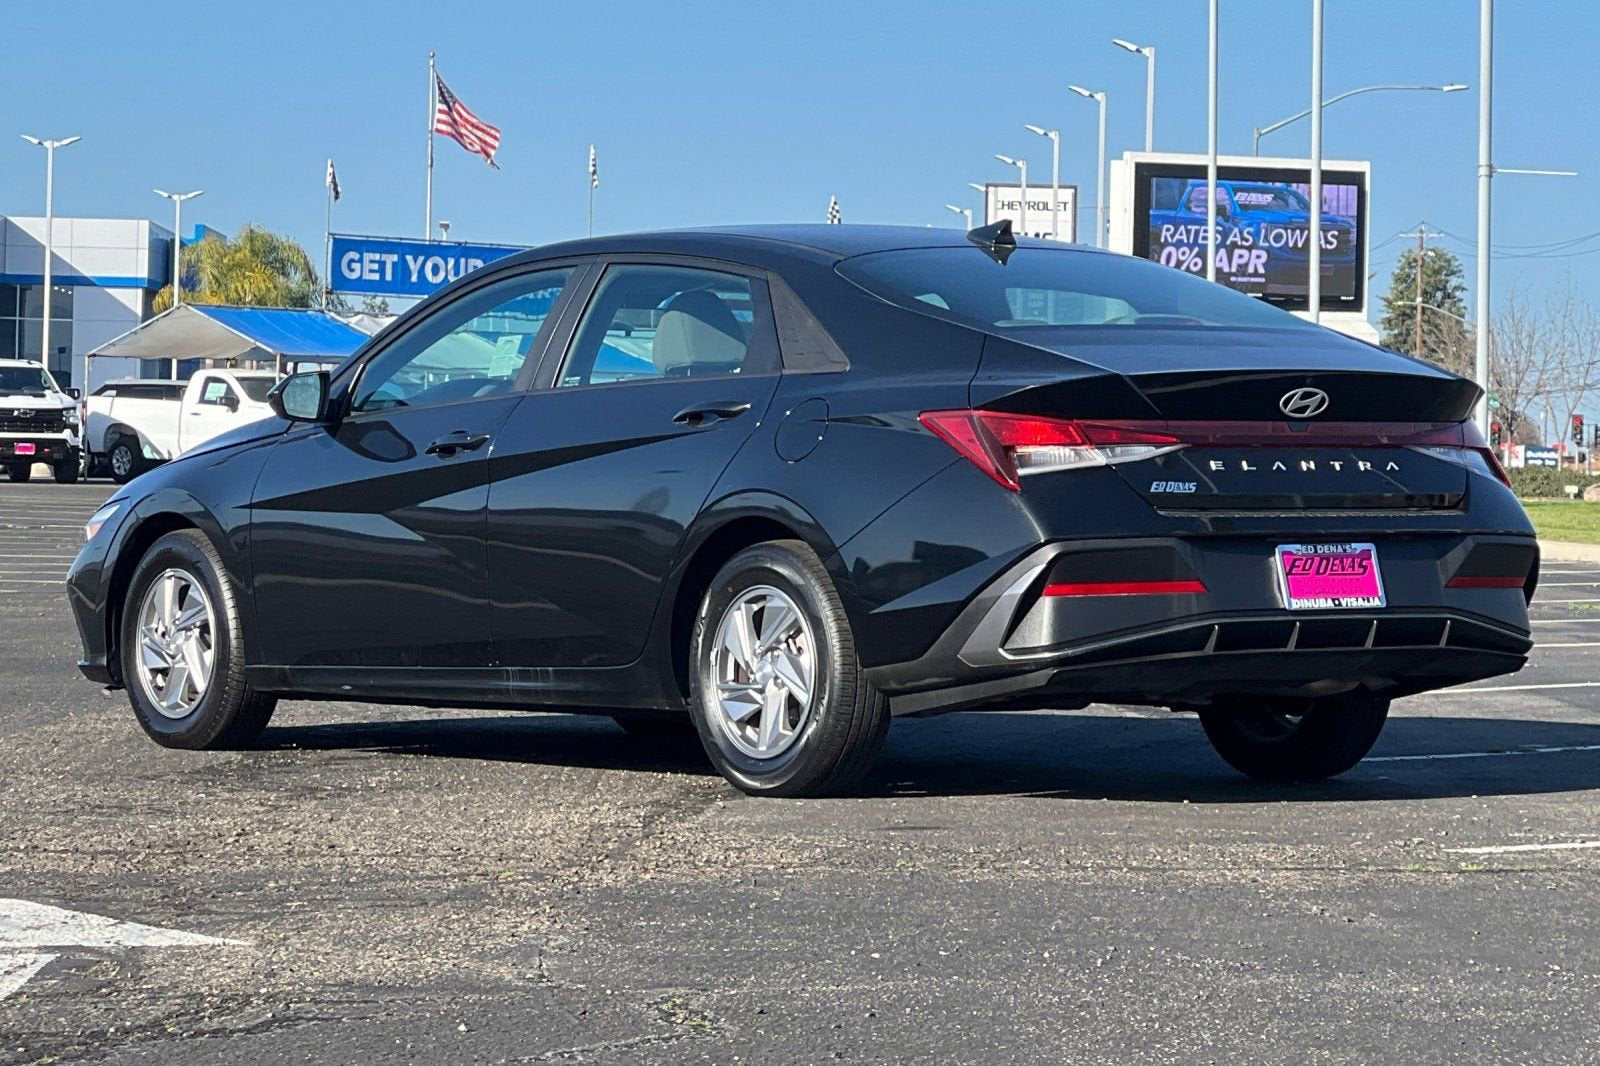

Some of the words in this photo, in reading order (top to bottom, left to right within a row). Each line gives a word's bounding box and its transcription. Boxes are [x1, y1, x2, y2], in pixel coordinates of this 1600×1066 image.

[1160, 224, 1223, 244] RATES
[1226, 226, 1254, 247] AS
[1259, 228, 1309, 249] LOW
[340, 250, 399, 282] GET
[1160, 245, 1203, 272] 0%
[1215, 248, 1268, 274] APR
[1209, 460, 1400, 472] ELANTRA
[1150, 481, 1166, 493] ED
[1303, 545, 1315, 554] ED
[1316, 544, 1351, 554] DENA'S
[1287, 557, 1315, 576] ED
[1314, 556, 1369, 576] DENA'S
[1292, 598, 1334, 608] DINUBA
[1341, 596, 1382, 607] VISALIA
